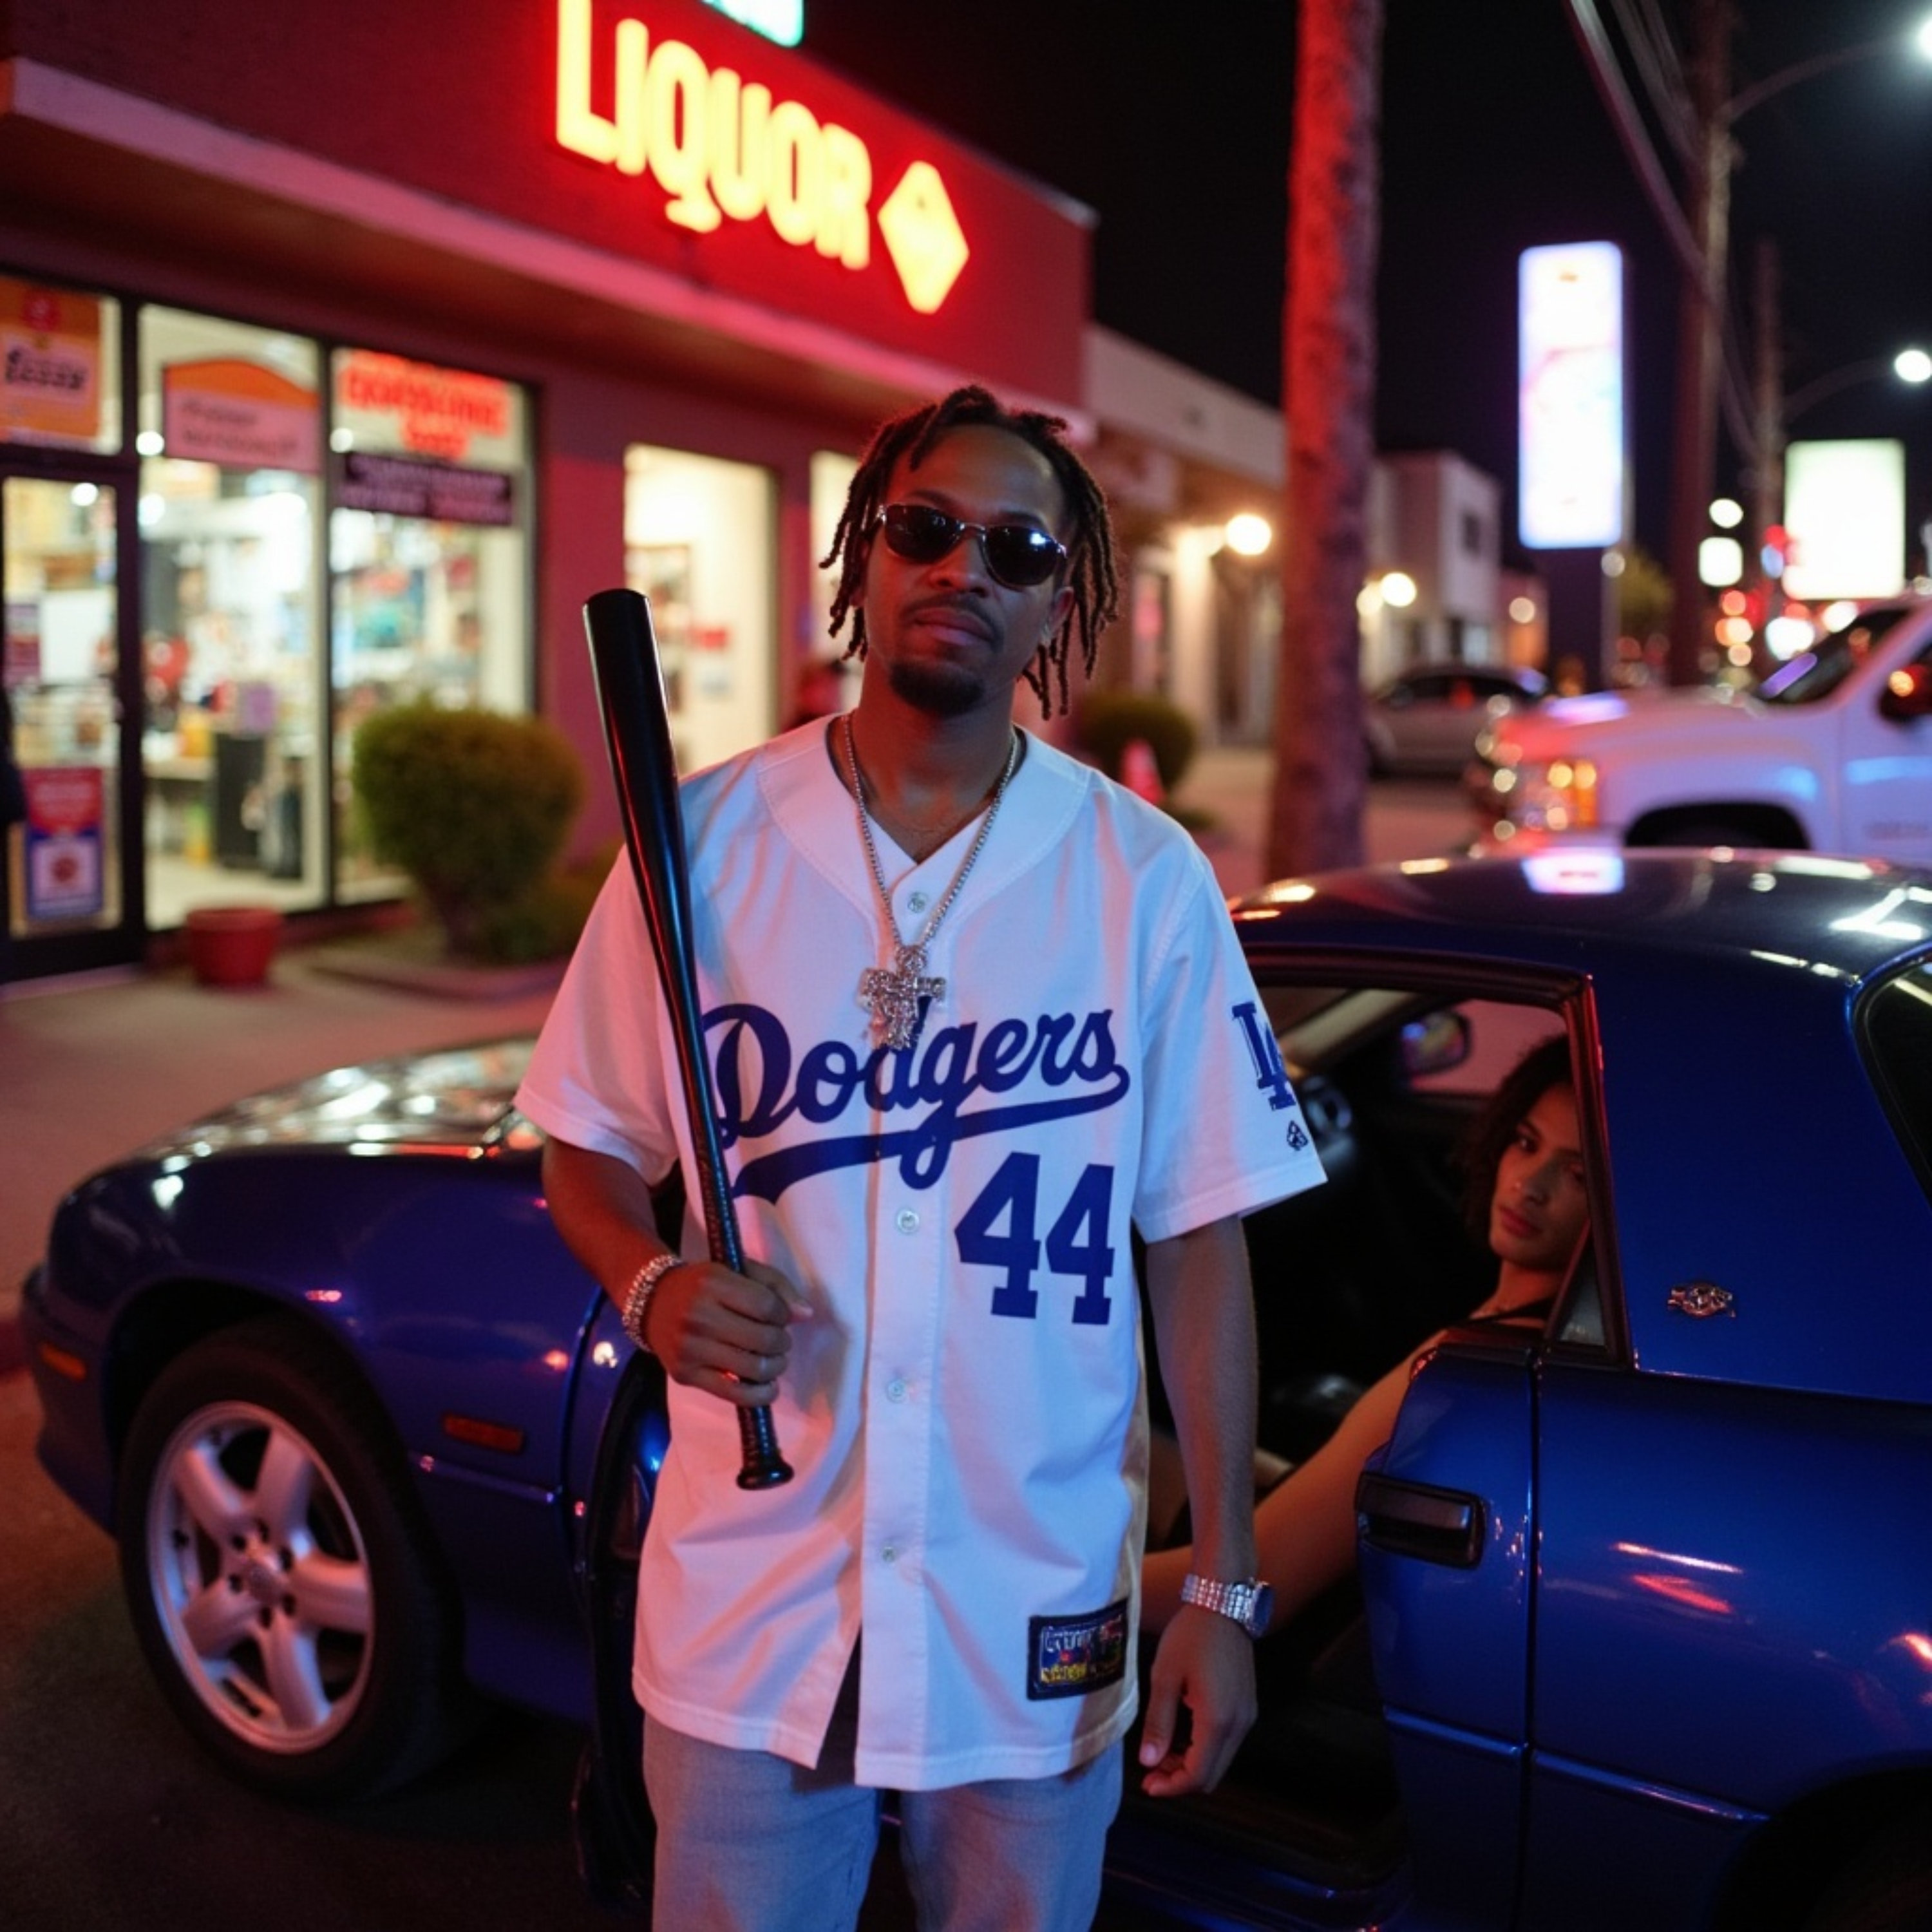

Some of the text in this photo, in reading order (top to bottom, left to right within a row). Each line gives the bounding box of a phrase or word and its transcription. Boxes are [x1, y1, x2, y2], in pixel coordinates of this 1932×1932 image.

[556, 0, 872, 270] LIQUOR
[701, 1002, 1130, 1191] Dodgers
[954, 1151, 1115, 1325] 44
